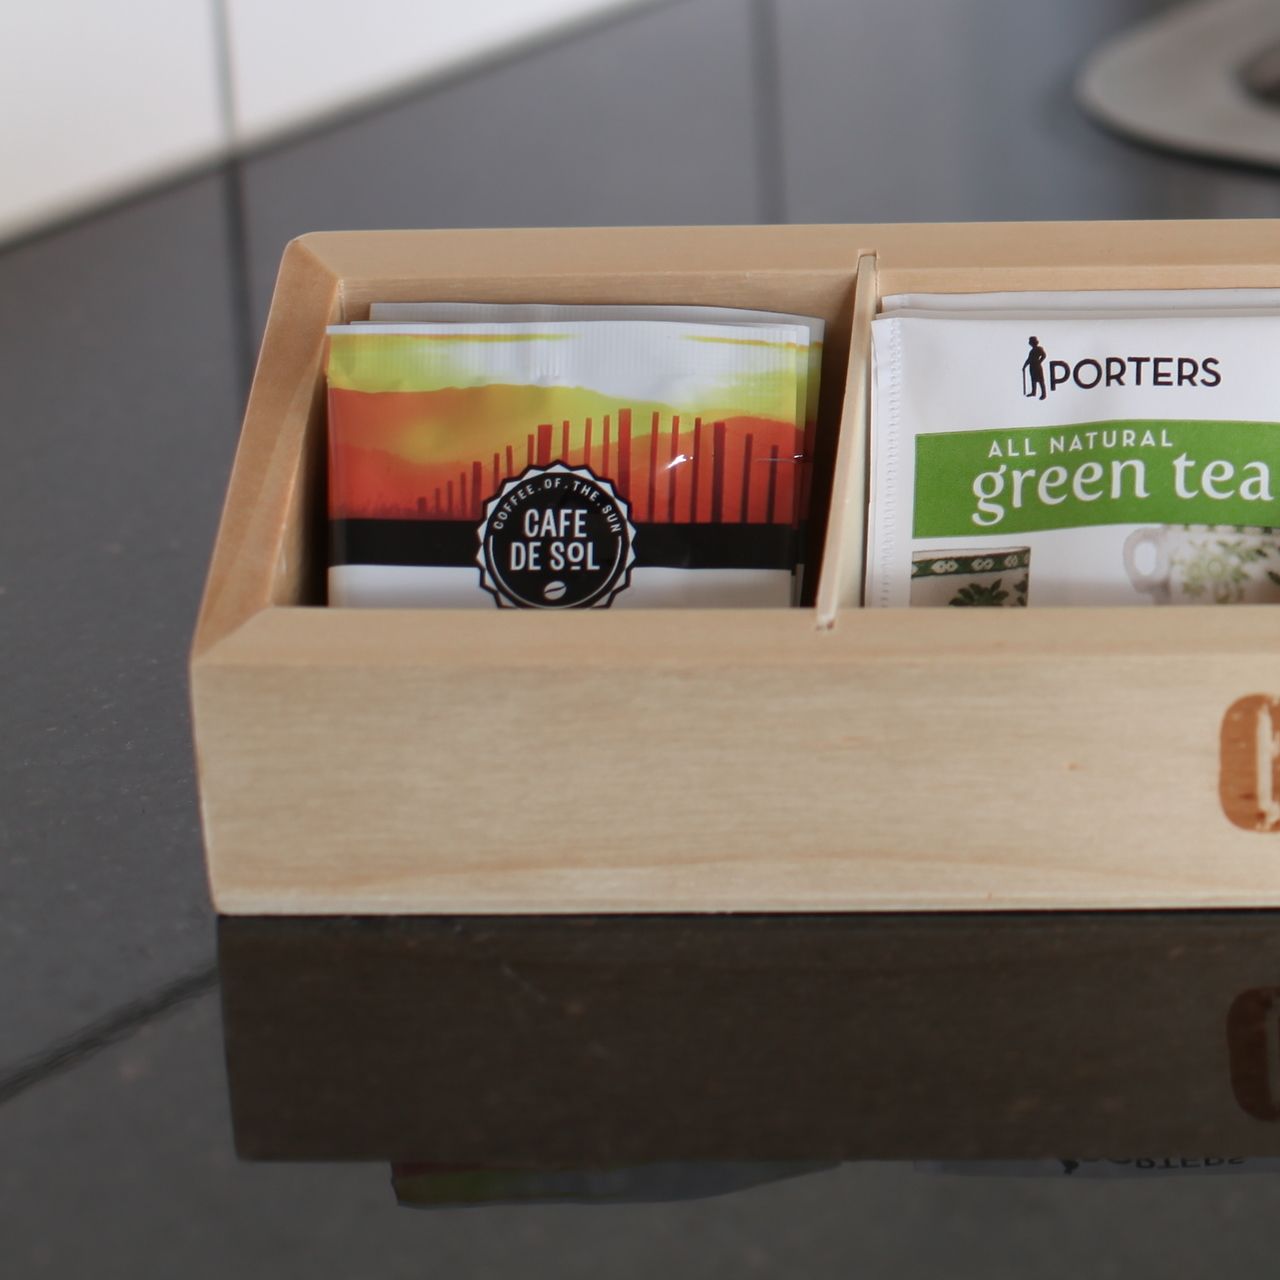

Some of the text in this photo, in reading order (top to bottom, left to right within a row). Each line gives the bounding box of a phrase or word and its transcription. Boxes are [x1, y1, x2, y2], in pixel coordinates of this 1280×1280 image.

[1048, 356, 1222, 392] PORTERS
[988, 428, 1173, 459] ALL NATURAL
[971, 452, 1275, 527] green tea
[524, 508, 588, 538] CAFE
[510, 541, 542, 571] DE
